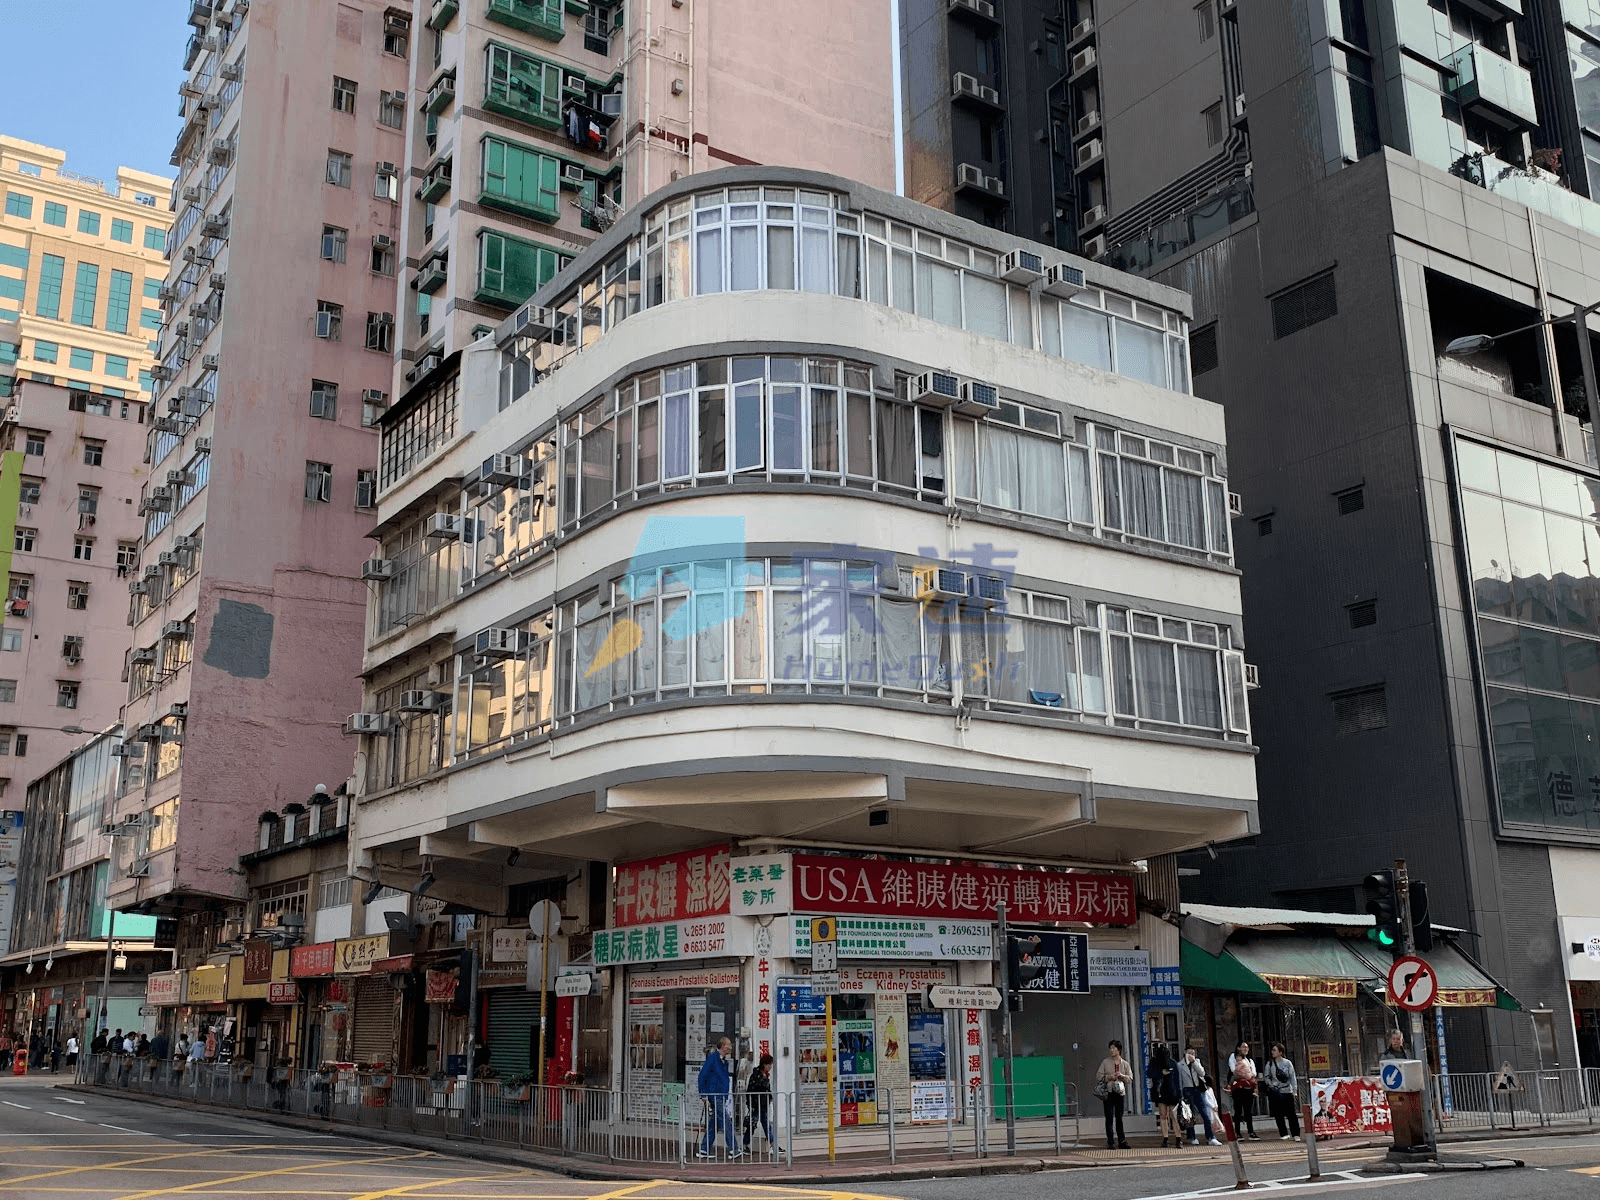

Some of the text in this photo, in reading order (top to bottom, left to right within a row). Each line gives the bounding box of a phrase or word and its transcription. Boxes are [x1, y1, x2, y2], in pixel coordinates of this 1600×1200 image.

[797, 865, 876, 904] USA
[881, 866, 1129, 917] 維胰健逆轉糖尿病
[742, 887, 776, 906] 診所
[691, 922, 725, 937] 2651 2002
[594, 925, 678, 964] 糖尿病救星
[691, 939, 725, 953] 6633 5477
[631, 977, 656, 988] Psoriasis
[657, 976, 677, 987] Eczema
[679, 975, 708, 986] Prostatitis
[857, 968, 893, 980] Eczema
[899, 968, 946, 980] Prostatitis
[877, 980, 909, 992] Kidney
[1360, 1089, 1389, 1107] 聖誕
